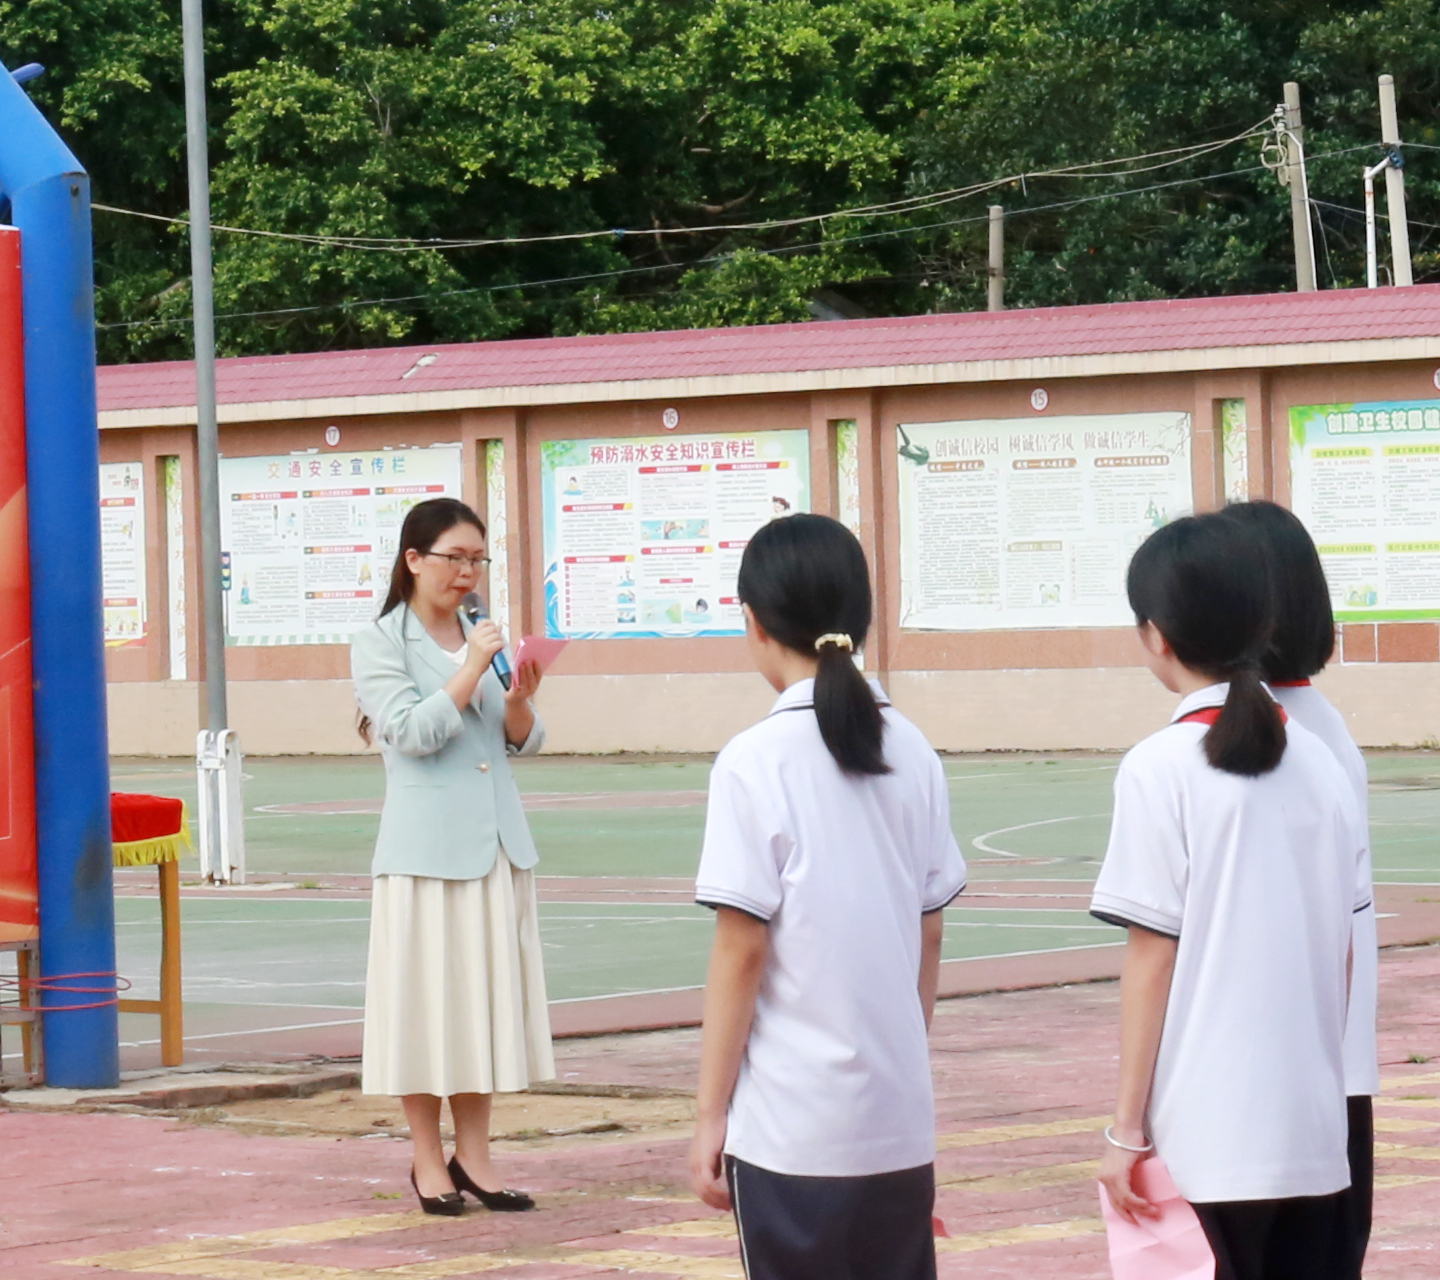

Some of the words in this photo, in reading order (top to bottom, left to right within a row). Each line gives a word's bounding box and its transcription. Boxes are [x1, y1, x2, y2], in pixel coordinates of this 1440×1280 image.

[1033, 392, 1046, 407] 15
[665, 411, 677, 425] 16
[327, 429, 338, 442] 17
[935, 436, 999, 457] 创诚信校园
[1009, 433, 1074, 453] 树诚信学风
[1083, 430, 1149, 451] 做诚信学生
[590, 439, 757, 464] 预防溺水安全知识宣传栏
[267, 456, 406, 480] 交通安全宣传栏
